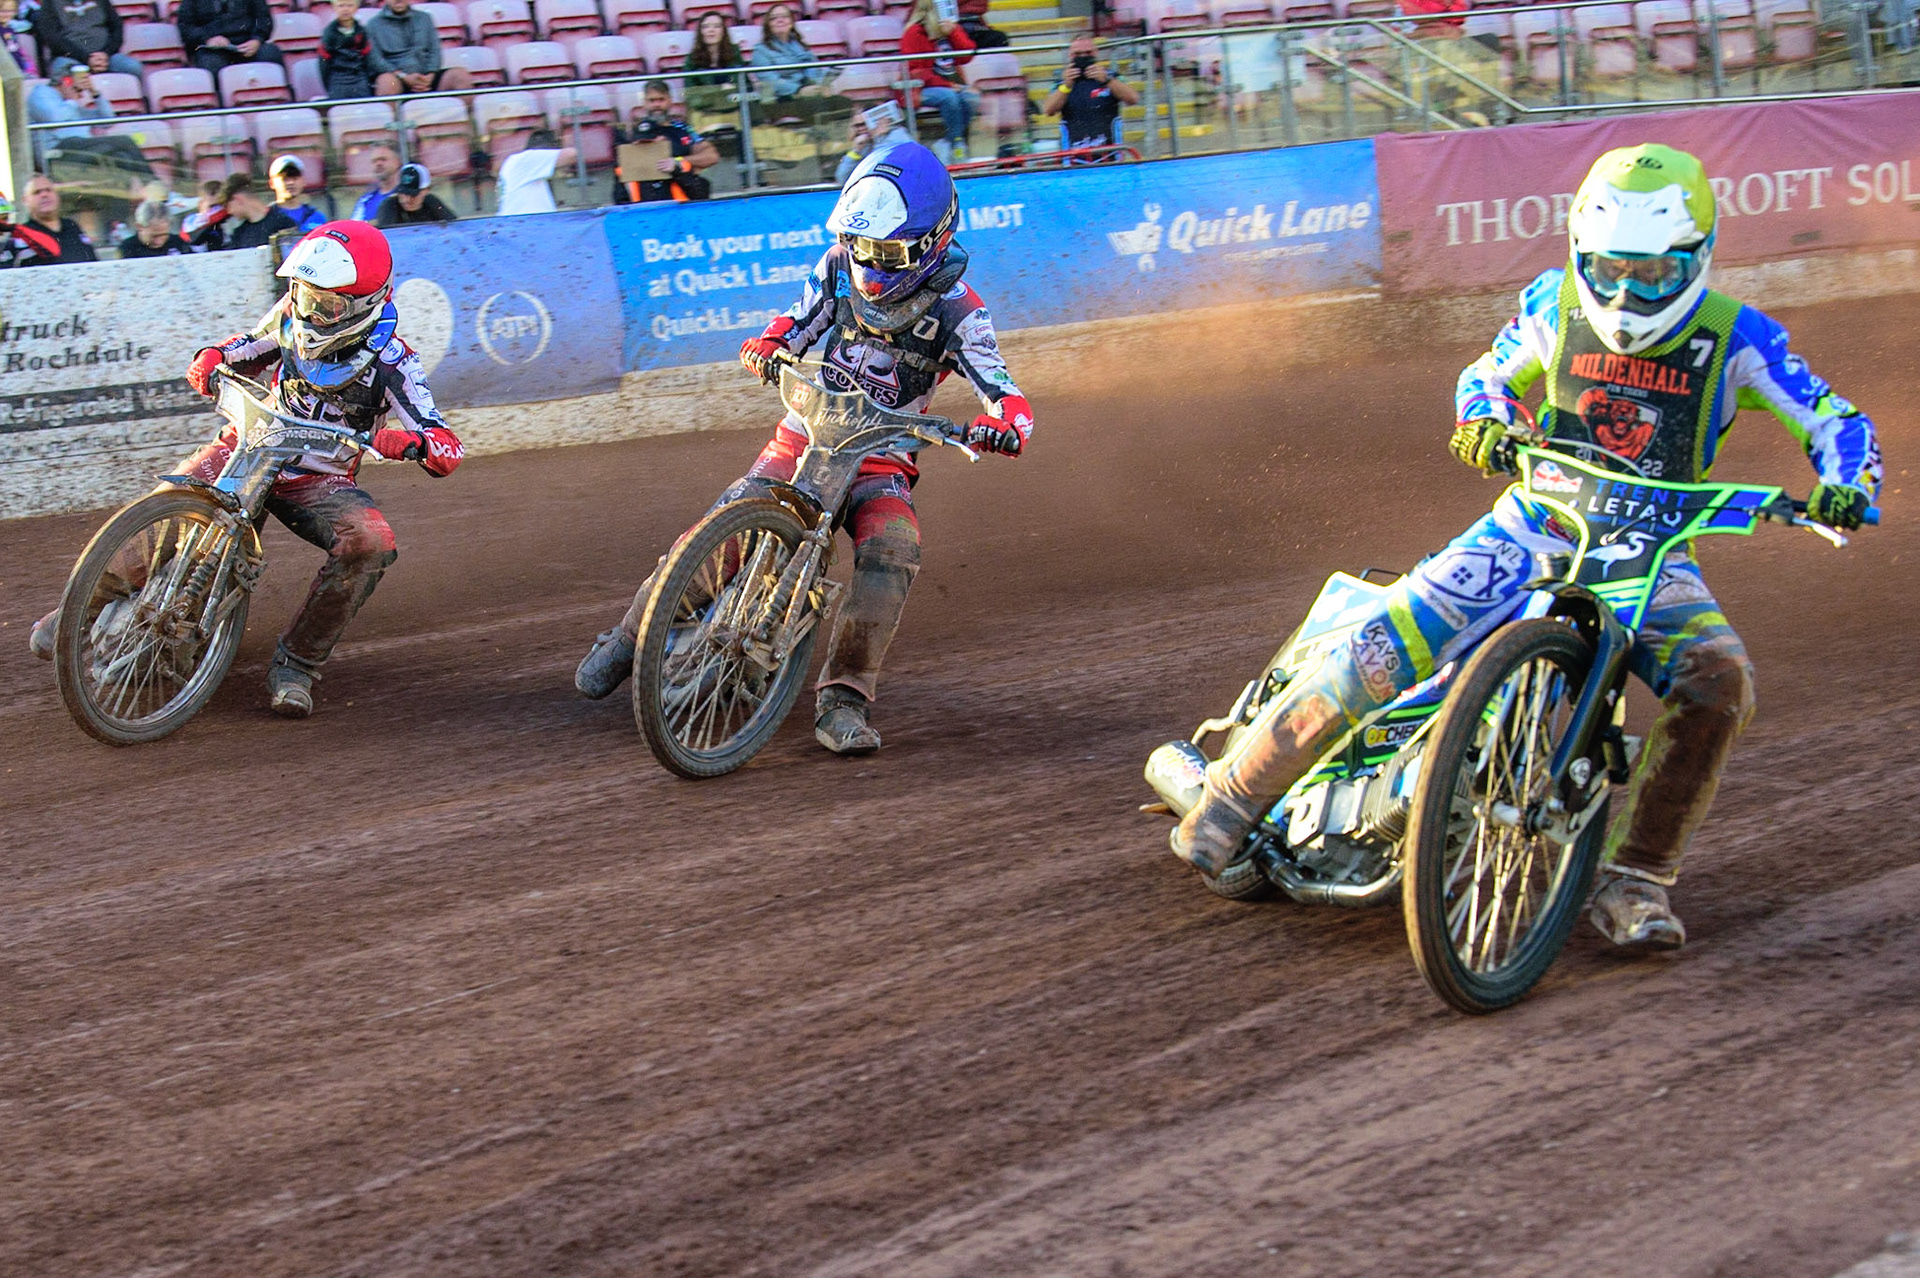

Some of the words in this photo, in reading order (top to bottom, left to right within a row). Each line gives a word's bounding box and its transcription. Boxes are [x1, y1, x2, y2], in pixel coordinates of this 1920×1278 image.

[642, 234, 705, 263] Book
[708, 233, 764, 262] your
[769, 224, 825, 250] next
[967, 203, 1025, 230] MOT
[1167, 204, 1275, 254] Quick
[1278, 200, 1372, 239] Lane
[648, 273, 672, 297] at
[674, 264, 749, 296] Quick
[752, 262, 812, 286] Lane
[1689, 338, 1715, 368] 7
[1570, 353, 1692, 396] MILDENHALL
[1641, 458, 1664, 477] 22
[1595, 479, 1690, 507] TRENT
[1368, 624, 1399, 671] KAYS
